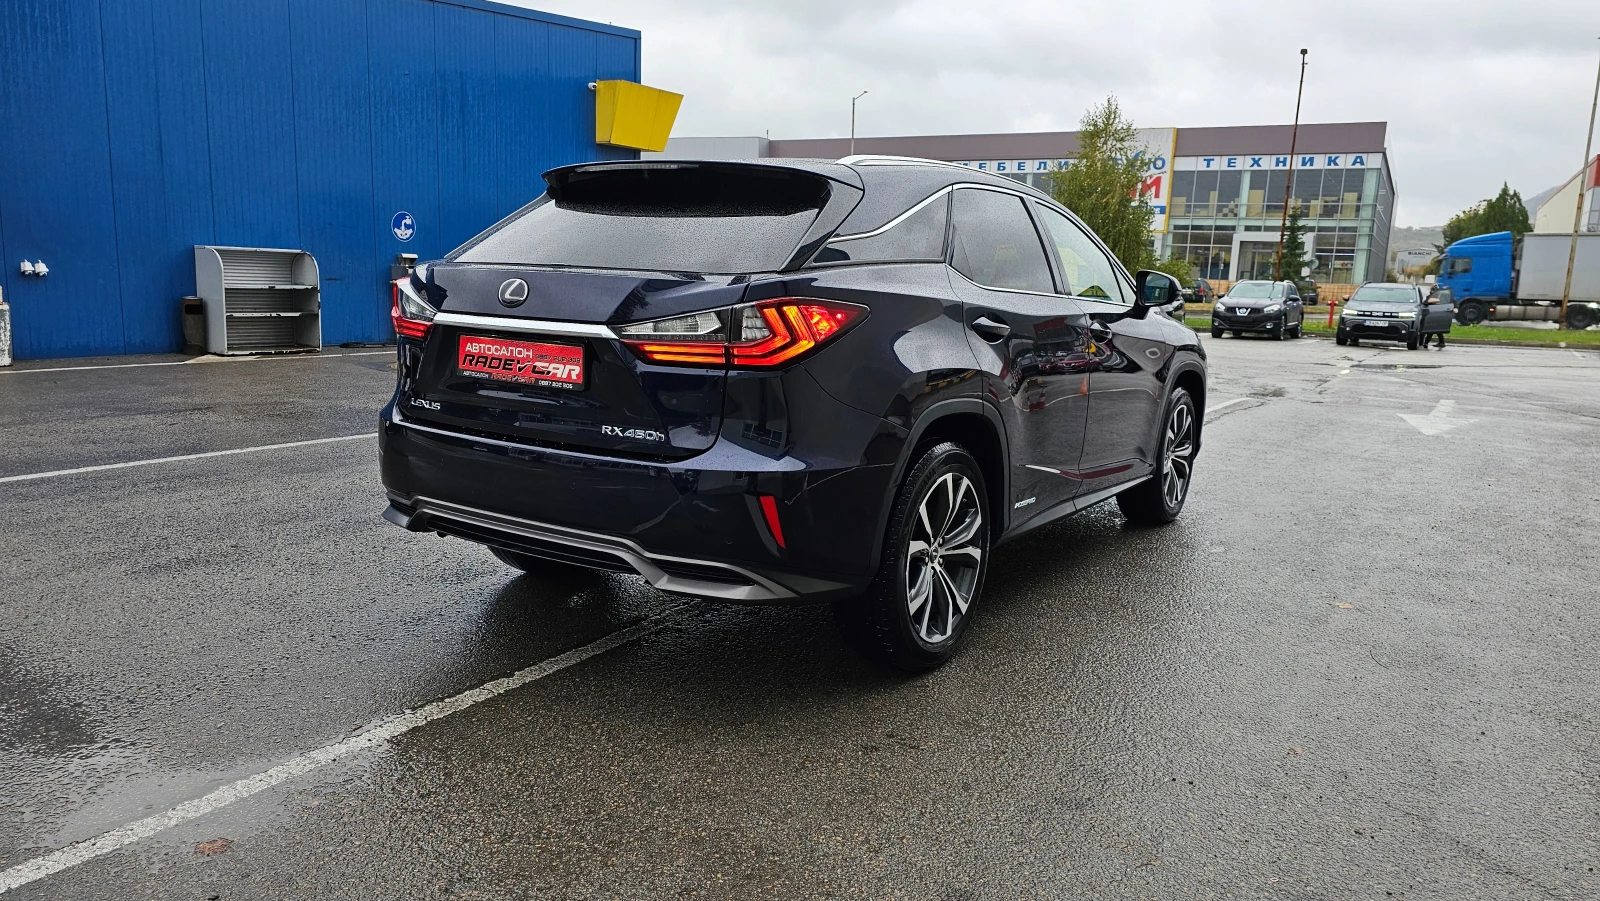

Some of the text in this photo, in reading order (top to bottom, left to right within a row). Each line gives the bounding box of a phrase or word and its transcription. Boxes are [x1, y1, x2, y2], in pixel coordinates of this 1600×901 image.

[1203, 155, 1366, 169] ТЕХНИКА
[465, 342, 533, 358] АВТОСАЛОН
[411, 397, 441, 411] LEXUS
